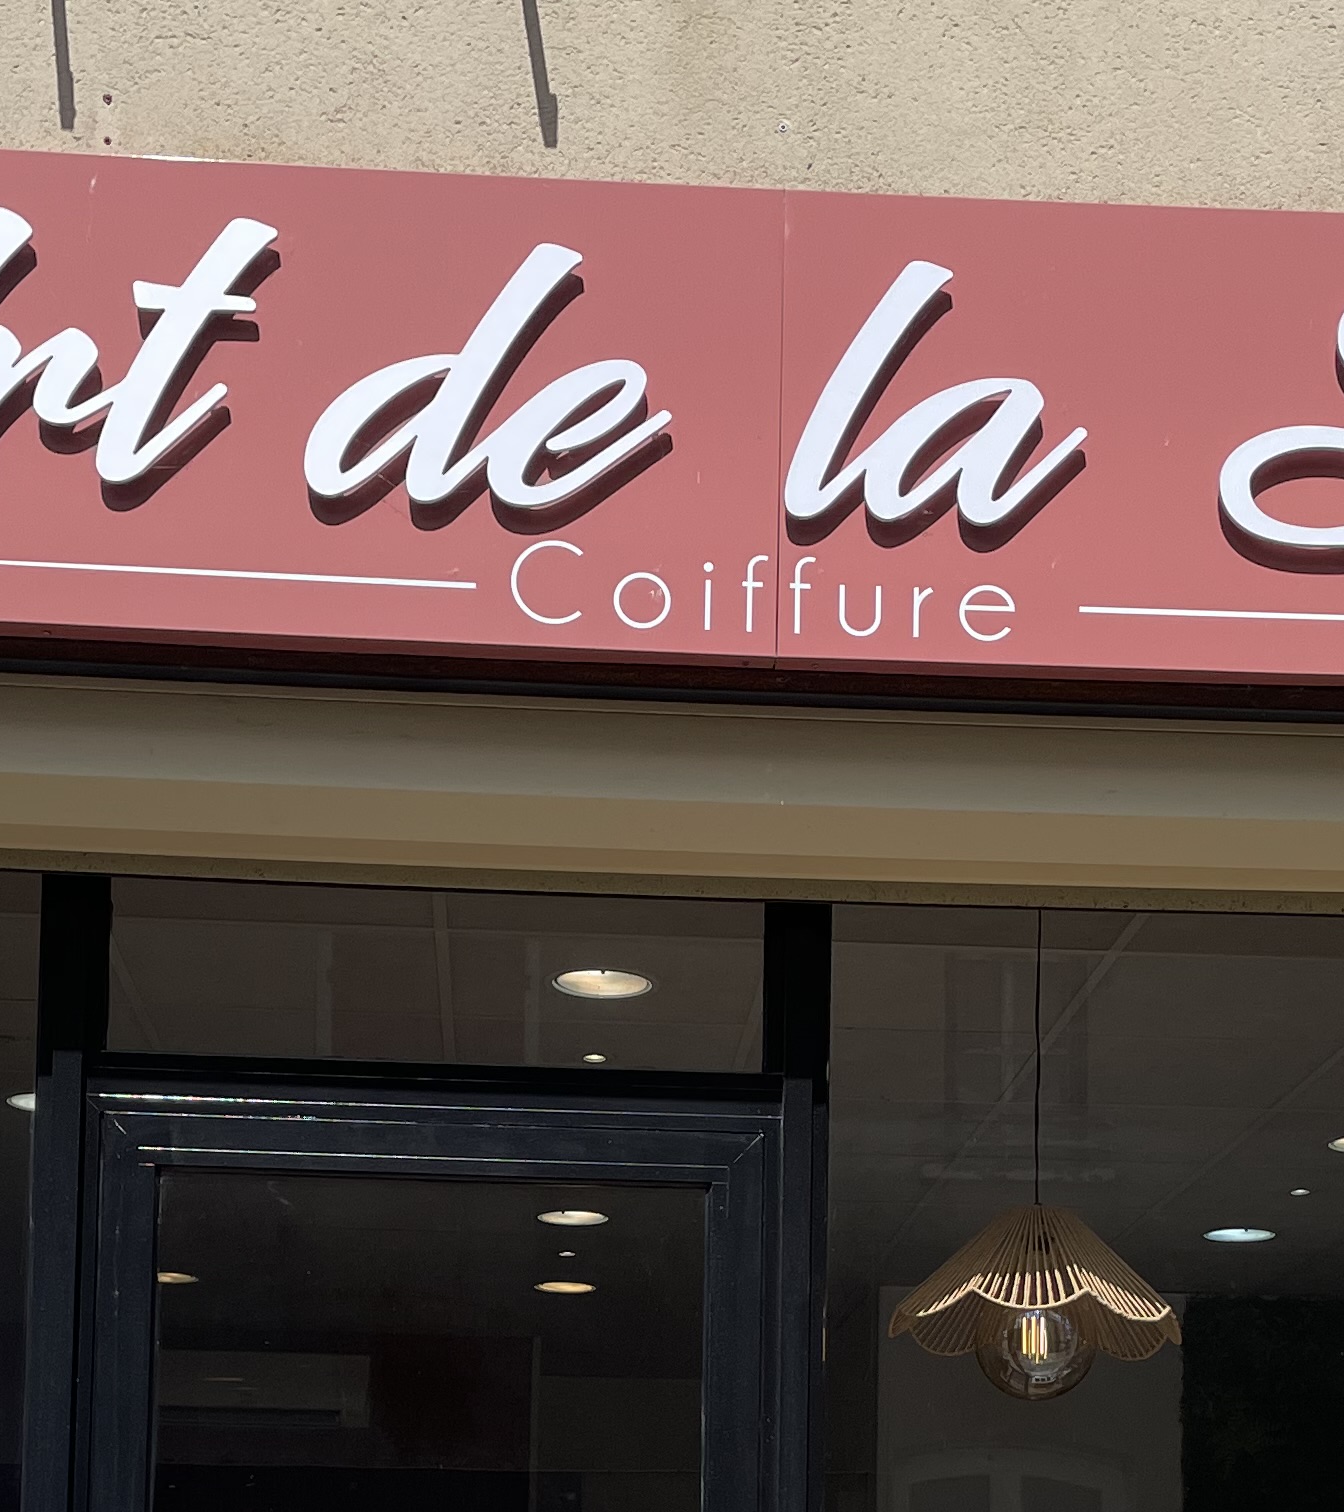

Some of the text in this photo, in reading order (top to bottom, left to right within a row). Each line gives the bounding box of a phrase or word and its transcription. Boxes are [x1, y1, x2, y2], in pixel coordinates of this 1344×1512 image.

[304, 243, 672, 510] de
[784, 260, 1088, 526] la
[511, 540, 1016, 643] Coiffure
